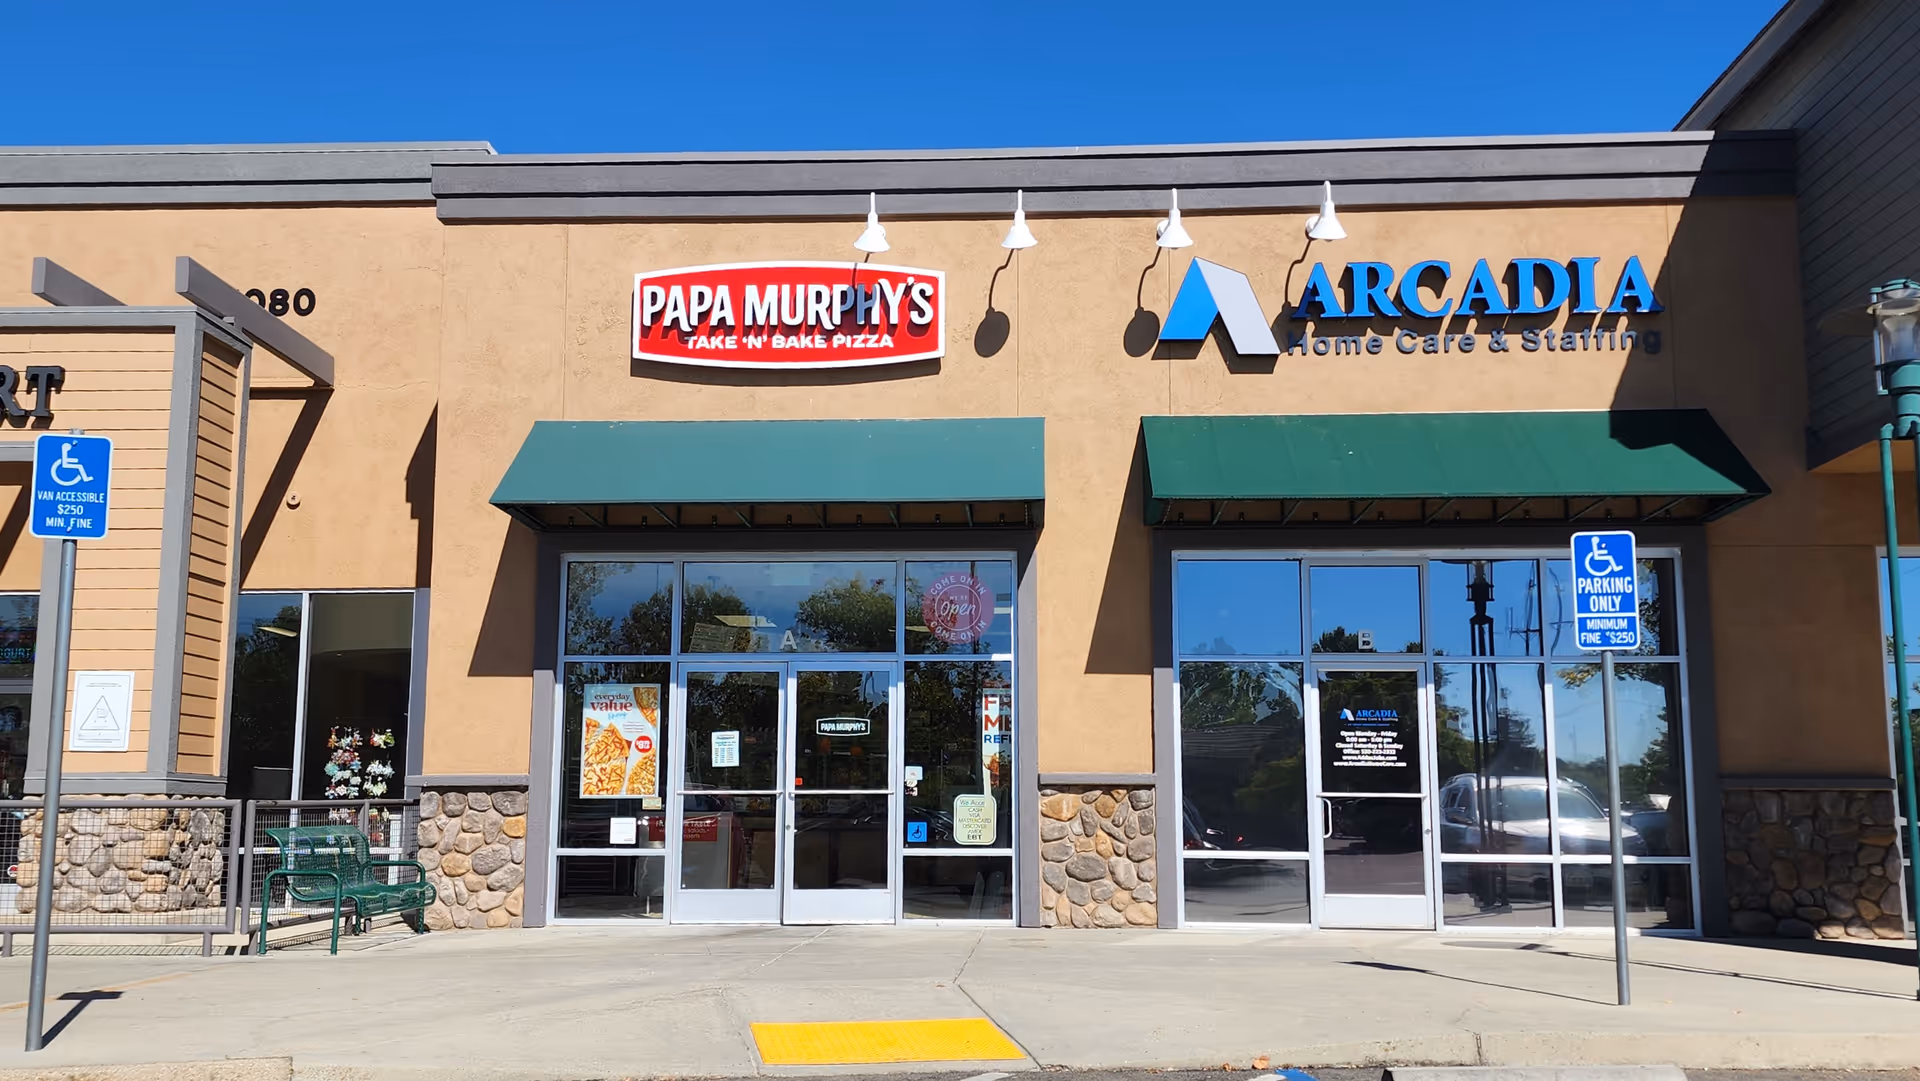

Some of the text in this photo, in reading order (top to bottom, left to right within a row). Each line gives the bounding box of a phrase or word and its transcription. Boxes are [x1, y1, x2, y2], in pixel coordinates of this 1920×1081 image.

[1292, 255, 1664, 319] ARCADIA
[642, 276, 934, 331] PAPA MURPHY'S
[685, 335, 738, 350] TAKE
[772, 334, 827, 349] BAKE
[832, 334, 894, 348] PIZZA
[1288, 326, 1662, 356] Home Care & Staffing
[38, 490, 105, 503] VAN ACCESSIBLE
[57, 504, 84, 515] $250
[45, 517, 93, 529] MIN. FINE
[930, 575, 987, 595] COME ON IN
[1577, 576, 1633, 594] PARKING
[941, 601, 976, 620] Open
[1590, 595, 1622, 612] ONLY
[930, 620, 987, 640] COME ON IN
[1586, 618, 1628, 630] MINIMUM
[780, 630, 798, 649] A
[1358, 630, 1373, 649] B
[1581, 632, 1602, 644] FINE
[590, 700, 633, 711] value
[1356, 709, 1398, 717] ARCADIA
[820, 722, 835, 731] PAPA
